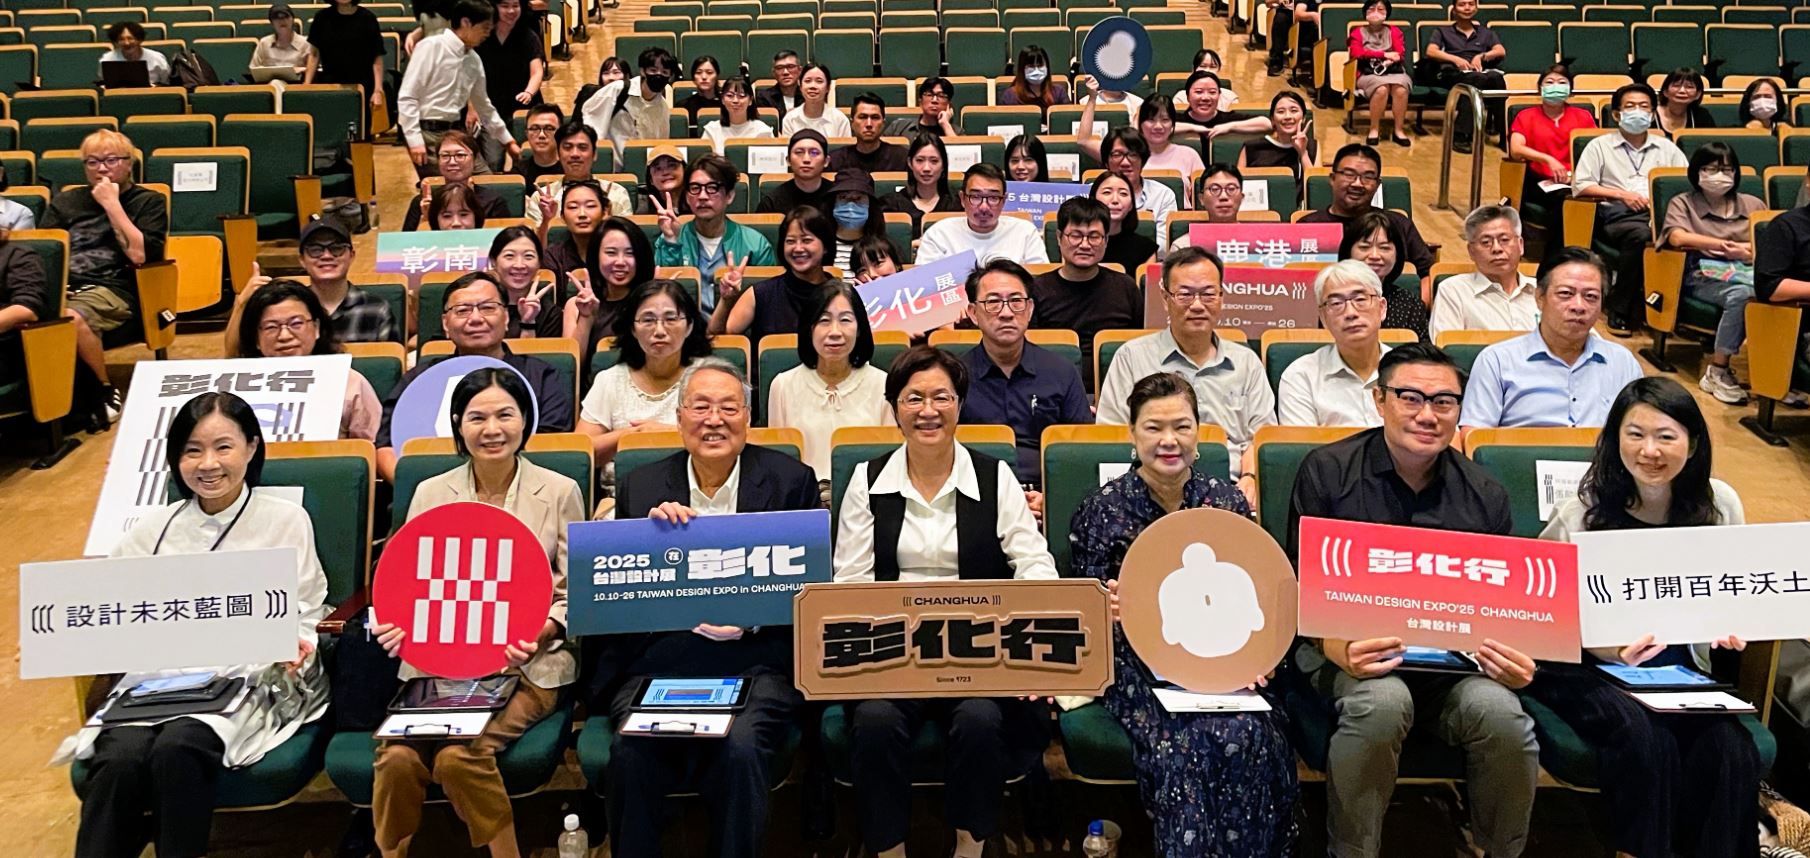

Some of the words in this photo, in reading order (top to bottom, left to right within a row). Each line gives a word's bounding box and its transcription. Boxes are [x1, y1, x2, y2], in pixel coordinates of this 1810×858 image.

[400, 245, 479, 273] 彰南
[1222, 282, 1289, 297] NGHUA
[158, 369, 315, 398] 彰化行
[593, 553, 651, 570] 2025
[687, 544, 806, 580] 彰化
[1368, 548, 1511, 587] 彰化行
[593, 567, 677, 585] 台灣設計展
[1622, 570, 1810, 601] 打開百年沃土
[594, 591, 635, 602] 10.10-26
[637, 588, 673, 600] TAIWAN
[676, 585, 711, 598] DESIGN
[713, 583, 738, 595] EXPO
[740, 583, 750, 594] in
[751, 581, 806, 594] CHANGHUA
[914, 596, 990, 607] CHANGHUA
[66, 594, 253, 629] 設計未來藍圖
[1324, 590, 1373, 605] TAIWAN
[1375, 596, 1421, 610] DESIGN
[1423, 600, 1475, 616] EXPO'25
[1480, 606, 1554, 624] CHANGHUA
[1407, 617, 1472, 634] 台灣設計展
[822, 617, 1087, 669] 彰化行
